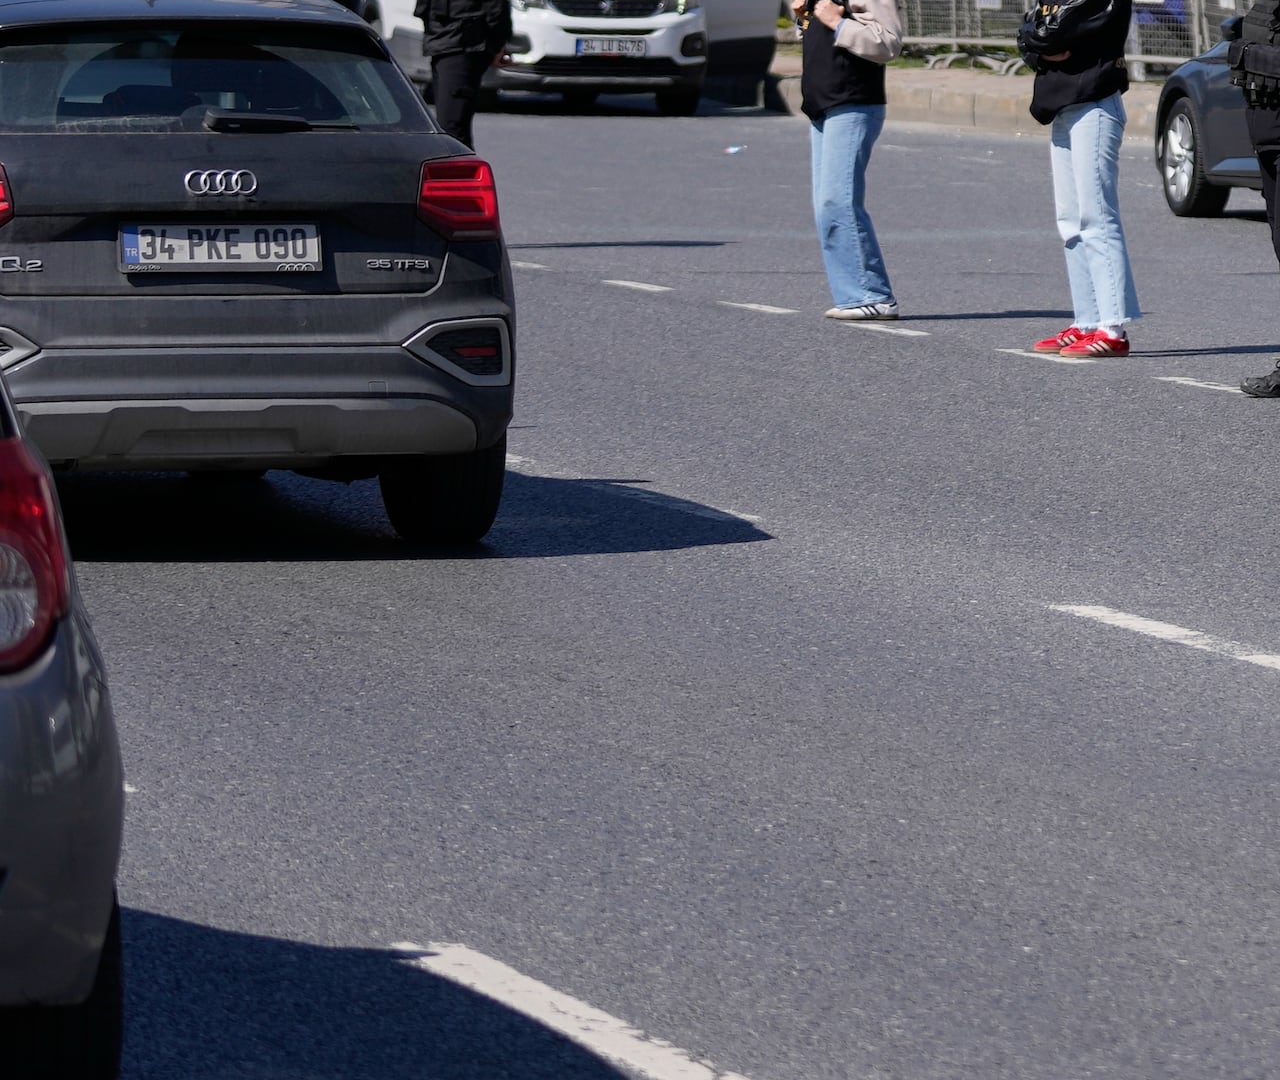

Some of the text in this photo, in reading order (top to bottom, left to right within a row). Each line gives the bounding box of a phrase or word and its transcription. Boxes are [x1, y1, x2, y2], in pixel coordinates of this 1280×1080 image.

[125, 228, 308, 261] TR 34 PKE 090
[366, 259, 430, 269] 35 TFSI
